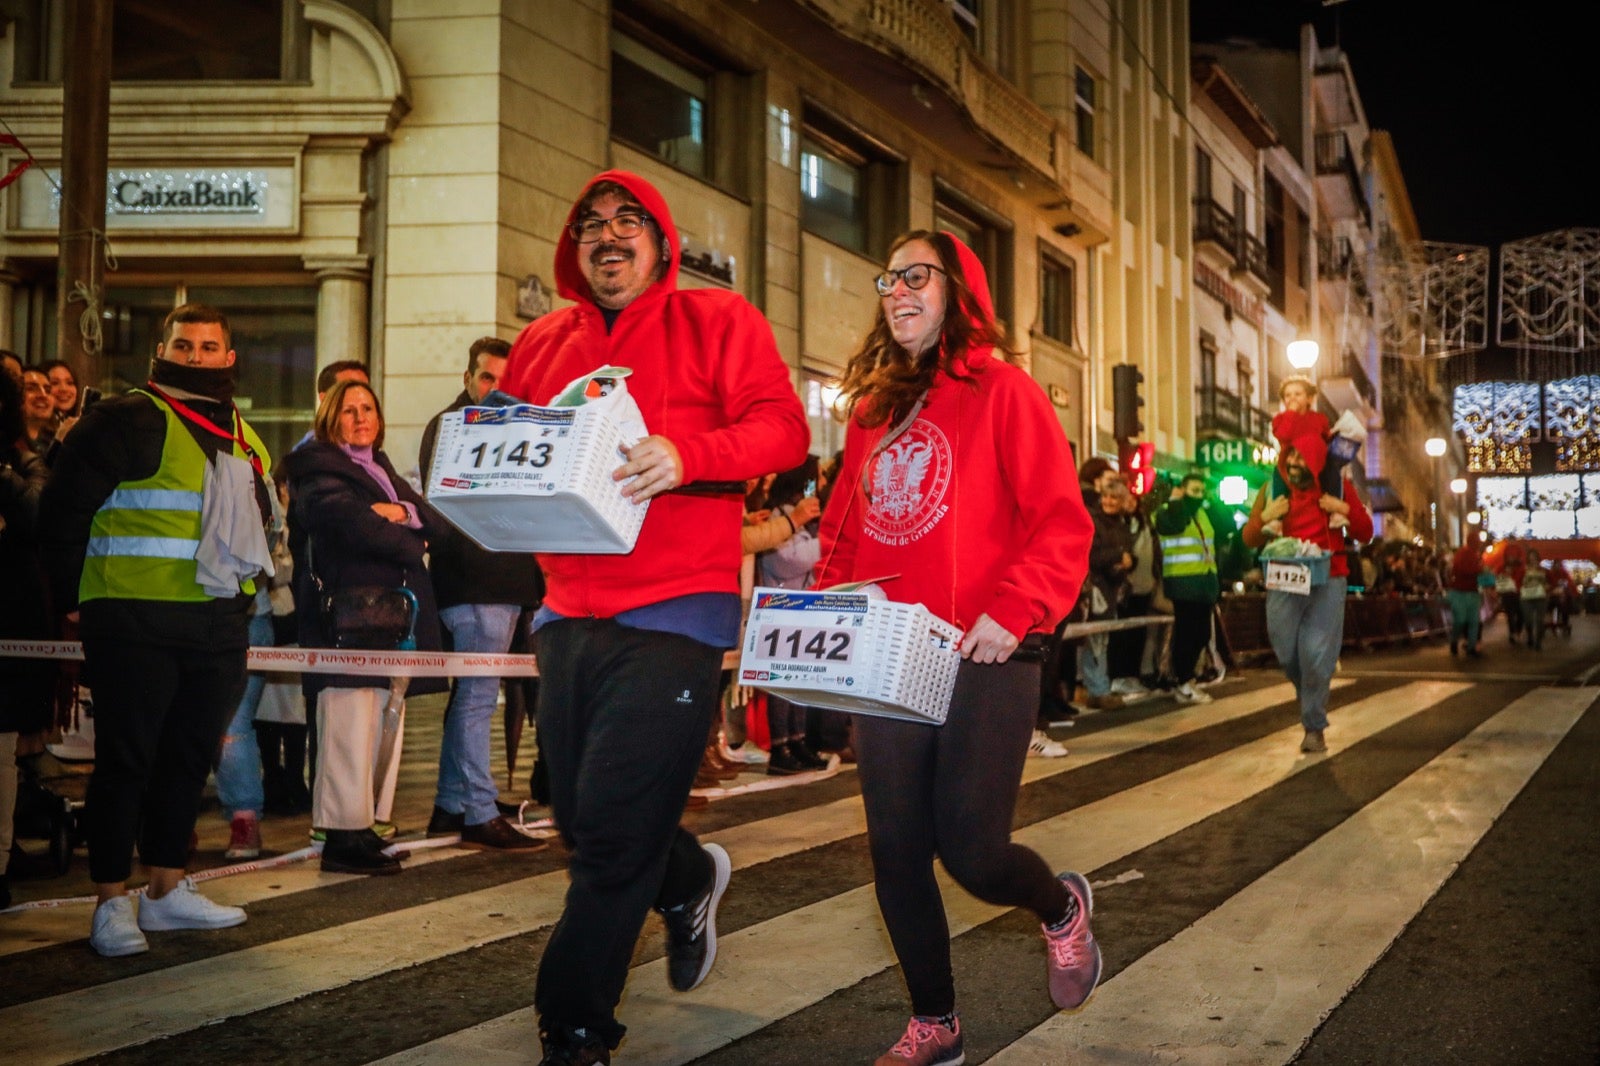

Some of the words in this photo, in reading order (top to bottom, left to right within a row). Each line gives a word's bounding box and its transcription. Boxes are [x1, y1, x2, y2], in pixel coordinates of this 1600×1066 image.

[115, 179, 258, 208] CaixaBank
[469, 440, 555, 469] 1143
[1200, 441, 1243, 464] 16H
[863, 526, 897, 546] ersidad
[899, 535, 909, 546] de
[910, 504, 949, 542] Granada
[763, 628, 851, 662] 1142
[320, 654, 367, 666] GRANADA
[369, 656, 382, 665] DE
[384, 656, 448, 668] AYUNTAMIENTO
[770, 663, 787, 671] TERESA
[787, 663, 813, 672] RODRIGUEZ
